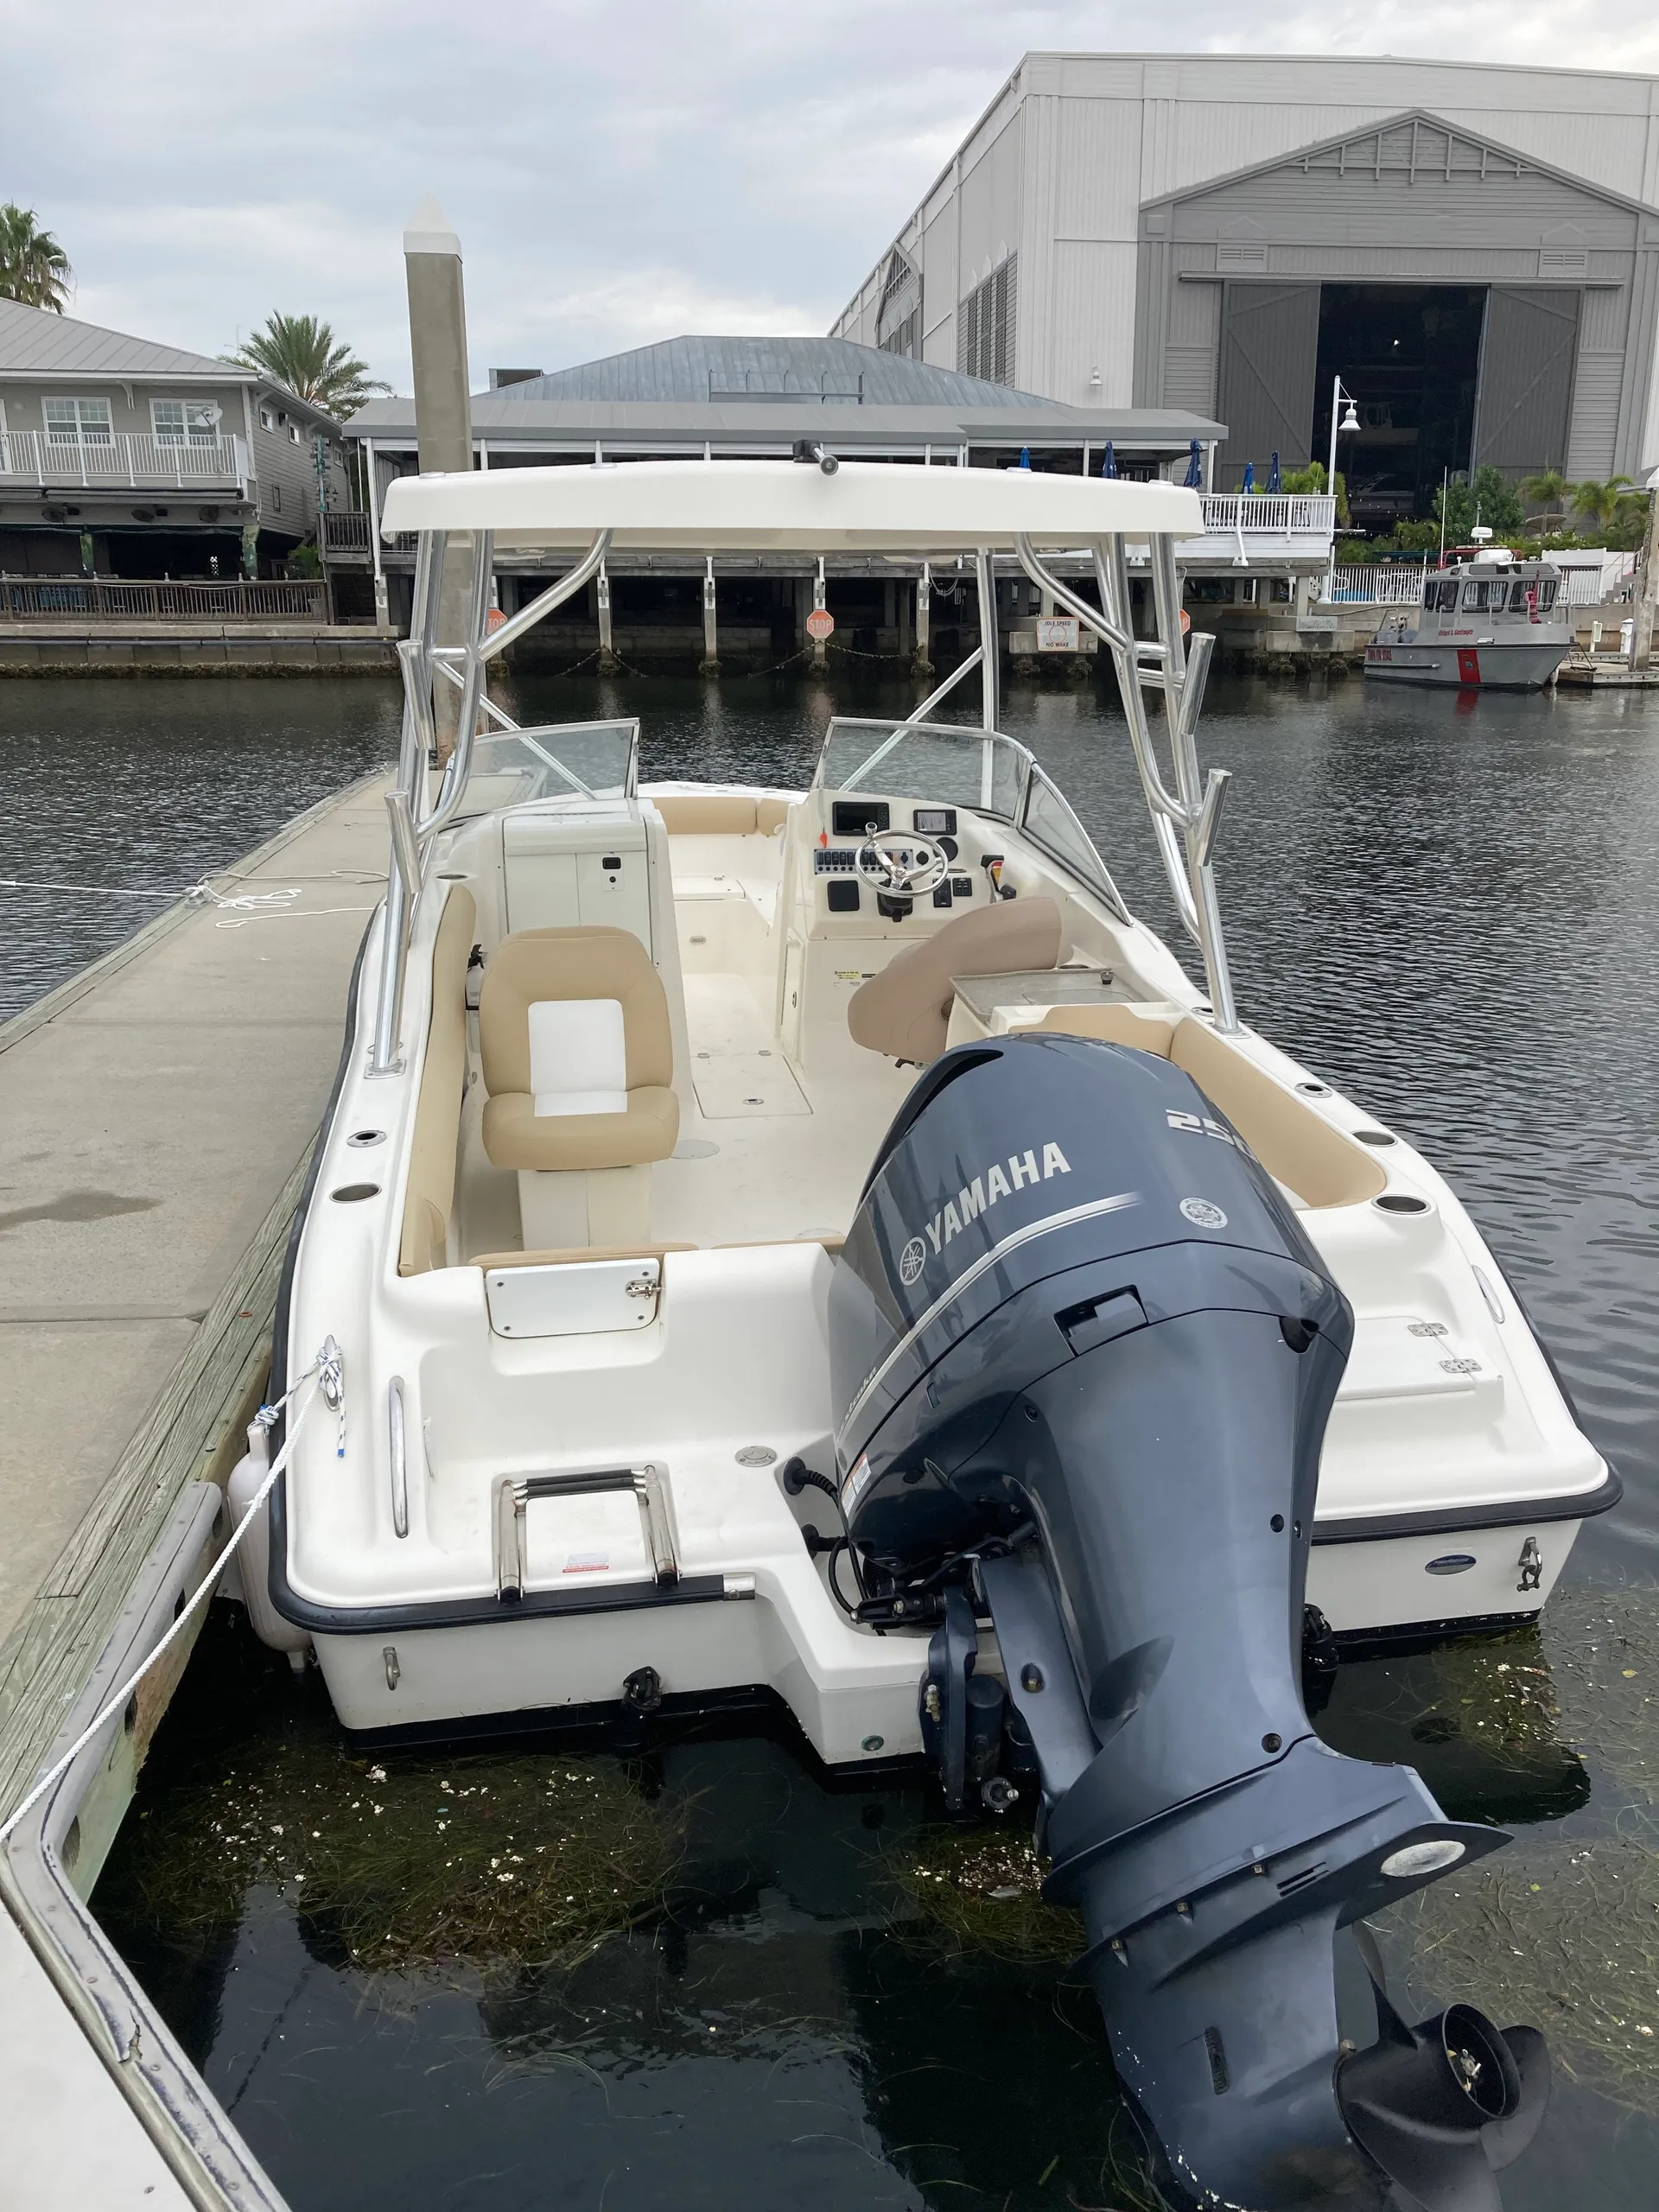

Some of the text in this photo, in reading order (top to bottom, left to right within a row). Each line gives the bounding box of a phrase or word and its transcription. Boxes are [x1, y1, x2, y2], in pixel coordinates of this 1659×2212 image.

[488, 618, 505, 628] TOP
[809, 619, 832, 630] STOP
[1165, 1109, 1260, 1165] 250
[925, 1141, 1072, 1255] YAMAHA
